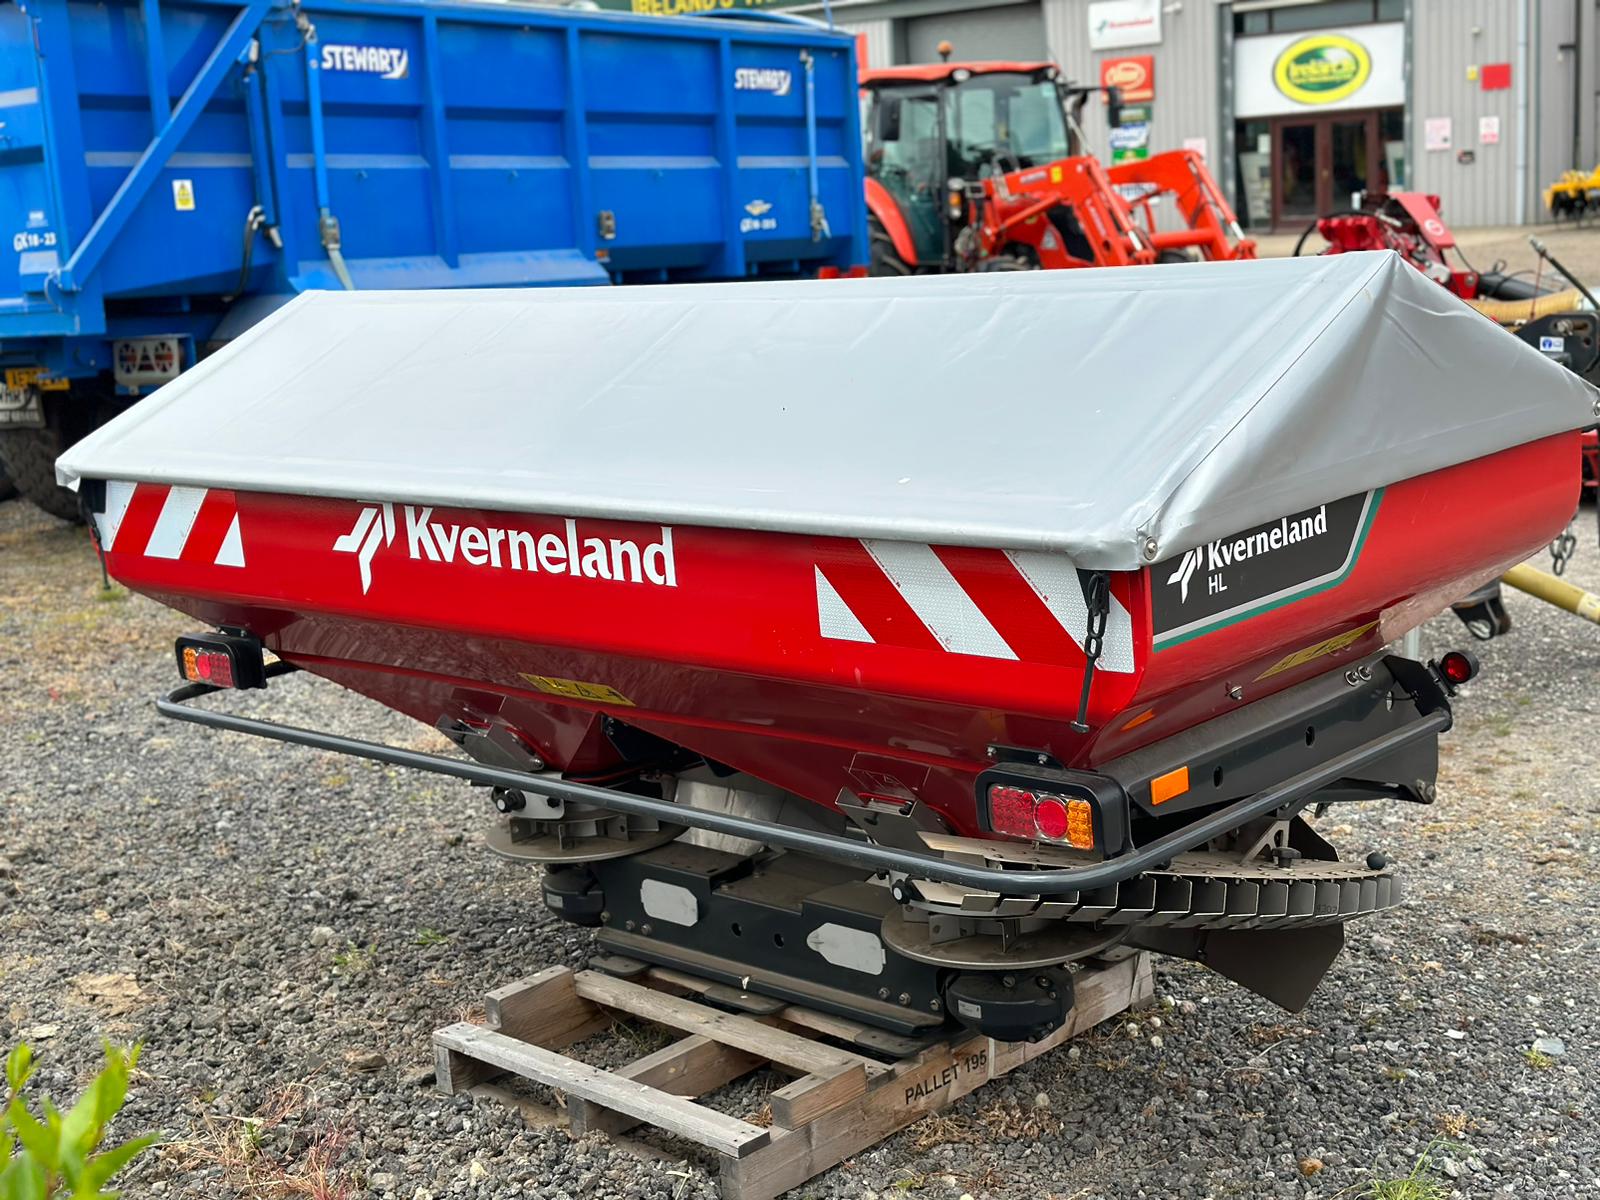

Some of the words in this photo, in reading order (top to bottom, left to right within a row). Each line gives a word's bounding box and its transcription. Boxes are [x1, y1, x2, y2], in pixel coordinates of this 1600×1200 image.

[321, 44, 405, 76] STEWART
[734, 68, 789, 93] STEWART
[404, 504, 678, 588] Kverneland
[1207, 504, 1328, 571] Kverneland
[1208, 573, 1228, 595] HL
[905, 1063, 960, 1105] PALLET
[964, 1049, 987, 1073] 195
